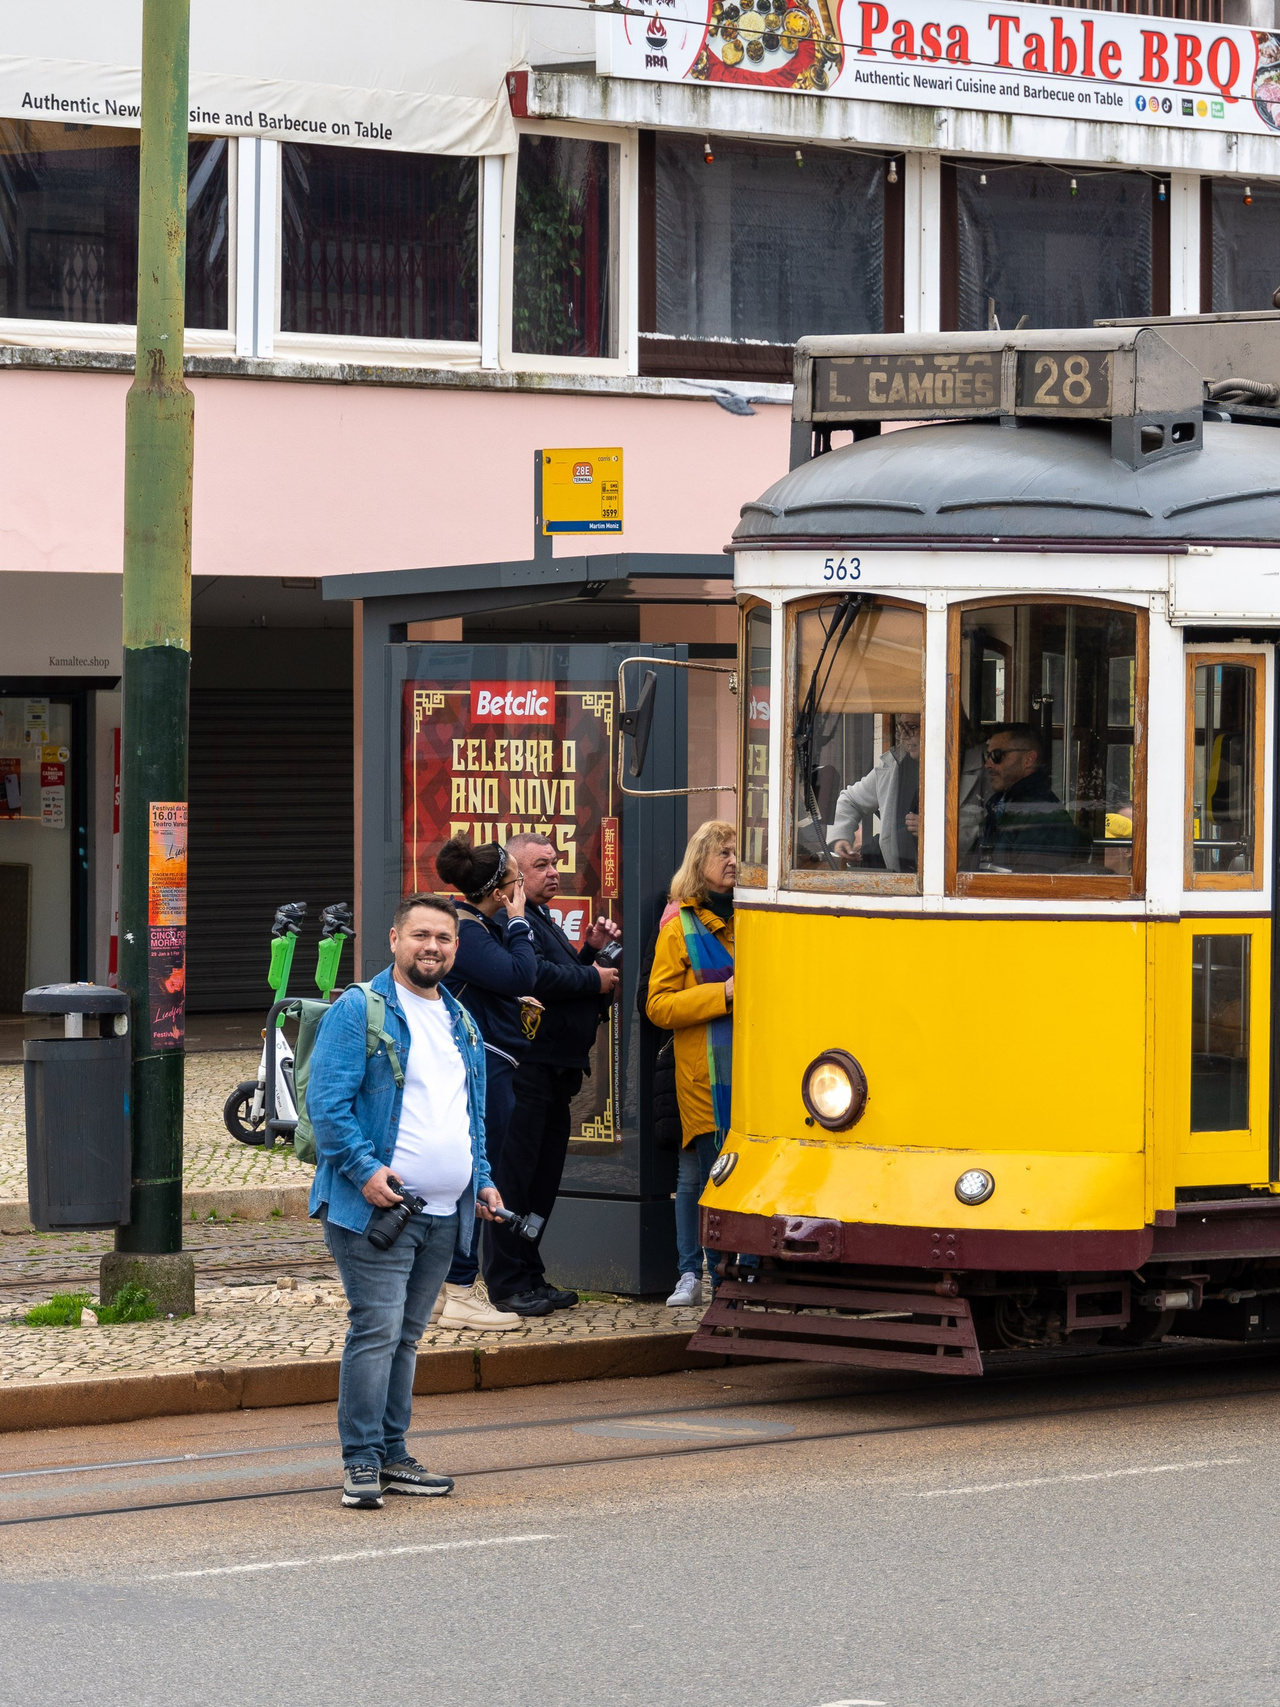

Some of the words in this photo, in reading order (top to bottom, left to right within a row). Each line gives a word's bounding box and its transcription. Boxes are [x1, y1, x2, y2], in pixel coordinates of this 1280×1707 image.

[858, 1, 972, 66] Pasa
[988, 14, 1124, 80] Table
[1139, 30, 1240, 104] BBQ
[854, 69, 911, 87] Authentic
[913, 74, 953, 91] Newari
[955, 78, 997, 94] Cuisine
[999, 83, 1021, 97] and
[1023, 84, 1075, 102] Barbecue
[1078, 92, 1092, 103] on
[1094, 92, 1124, 107] Table
[21, 92, 100, 114] Authentic
[105, 99, 142, 118] New
[189, 108, 221, 125] sine
[225, 111, 254, 128] and
[259, 113, 327, 135] Barbecue
[331, 122, 351, 136] on
[355, 121, 393, 141] Table
[829, 371, 851, 403] L.
[868, 368, 994, 405] CAMÕES
[1034, 355, 1092, 405] 28
[575, 466, 590, 476] 28E
[602, 509, 618, 517] 3599
[823, 558, 861, 581] 563
[49, 656, 110, 669] Kamaltec.shop
[477, 689, 549, 716] Betclic
[452, 739, 554, 777] CELEBRA
[562, 740, 576, 773] O
[450, 778, 499, 814] ANO
[509, 778, 576, 815] NOVO
[152, 811, 177, 821] 16.01
[604, 828, 615, 887] 新年快乐
[151, 931, 176, 939] CINCO
[151, 939, 182, 947] MORRER
